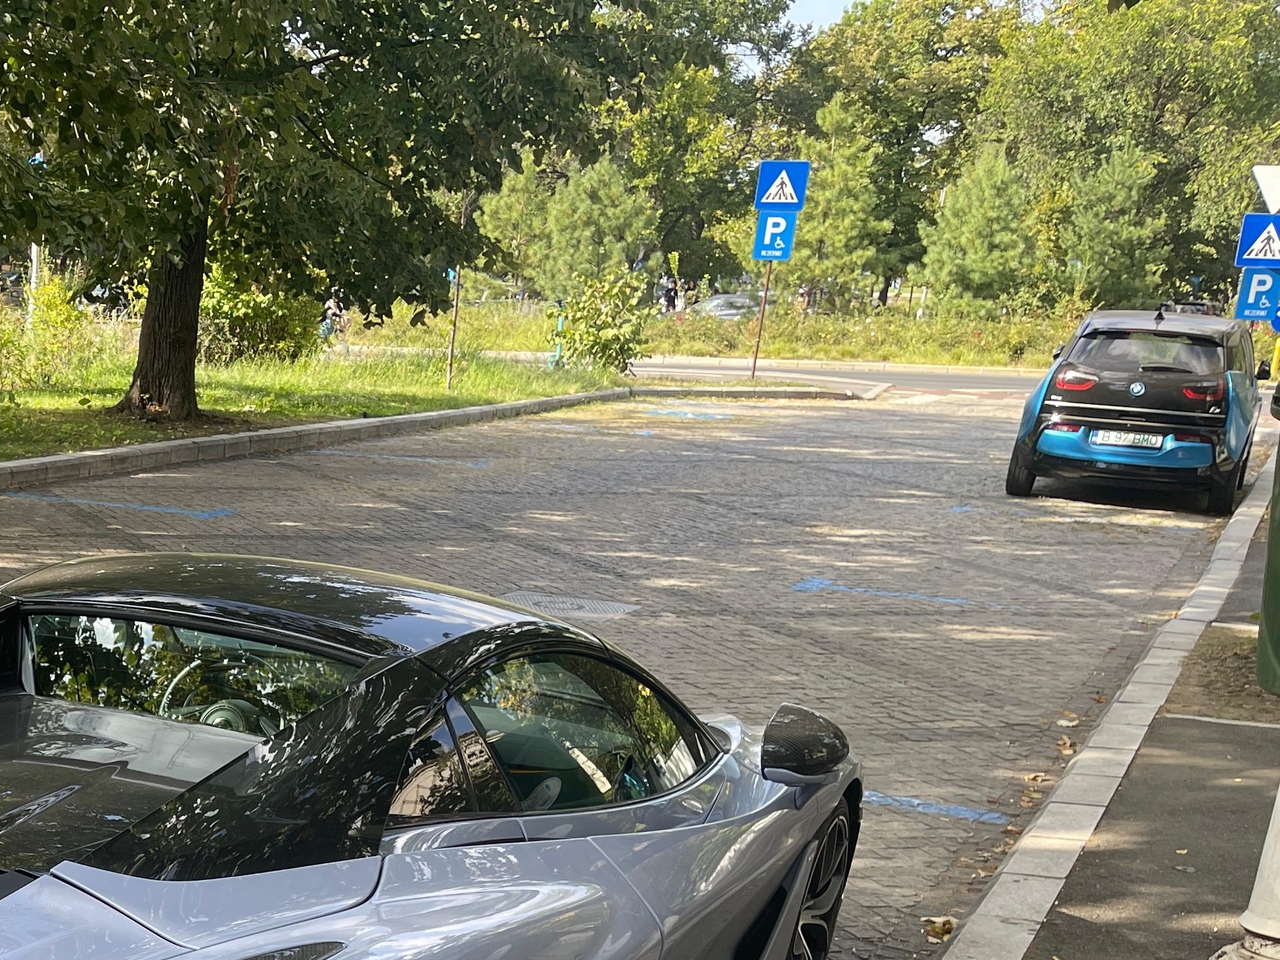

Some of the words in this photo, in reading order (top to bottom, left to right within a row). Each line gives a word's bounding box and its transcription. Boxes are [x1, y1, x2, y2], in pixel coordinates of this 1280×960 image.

[763, 216, 787, 245] P
[1247, 274, 1273, 304] P
[1102, 431, 1111, 442] B
